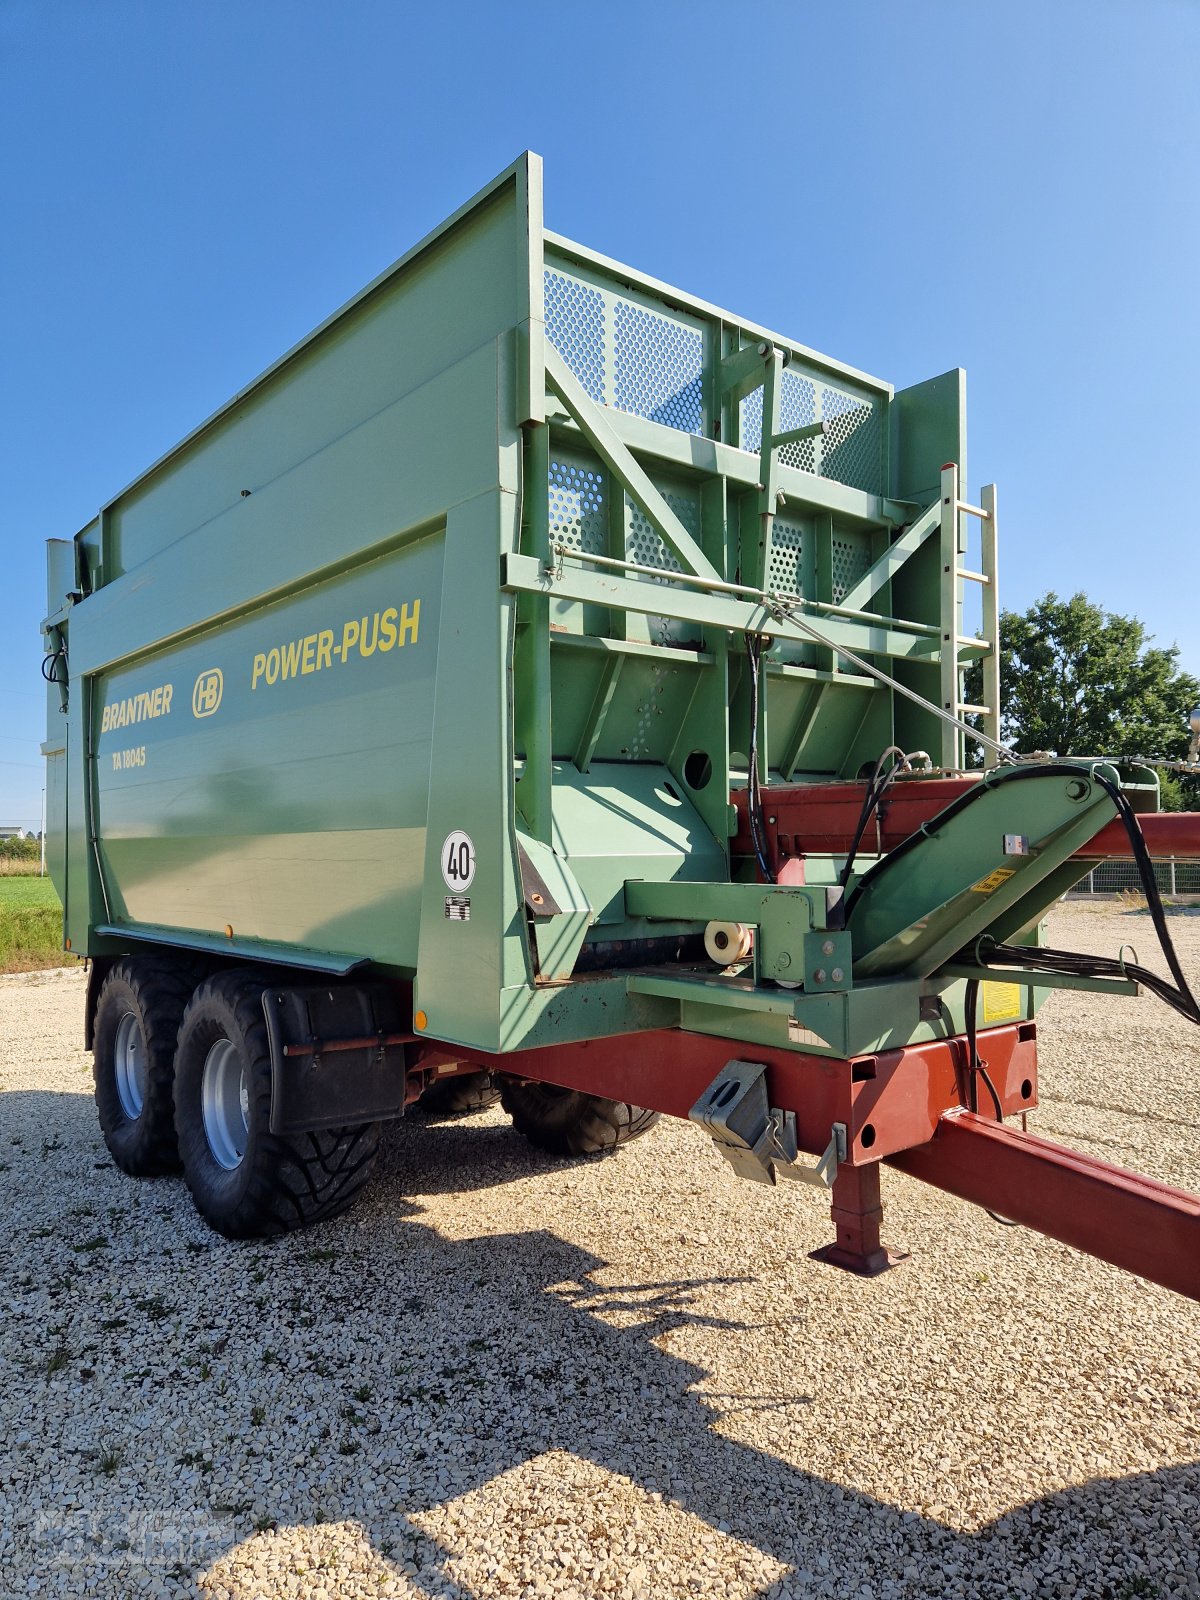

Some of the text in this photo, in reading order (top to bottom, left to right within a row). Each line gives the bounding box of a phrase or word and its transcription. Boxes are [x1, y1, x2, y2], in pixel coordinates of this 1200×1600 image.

[251, 599, 421, 690] POWER-PUSH
[101, 683, 173, 733] BRANTNER
[197, 675, 218, 712] HB
[112, 746, 146, 770] TA 18045
[447, 841, 470, 881] 40
